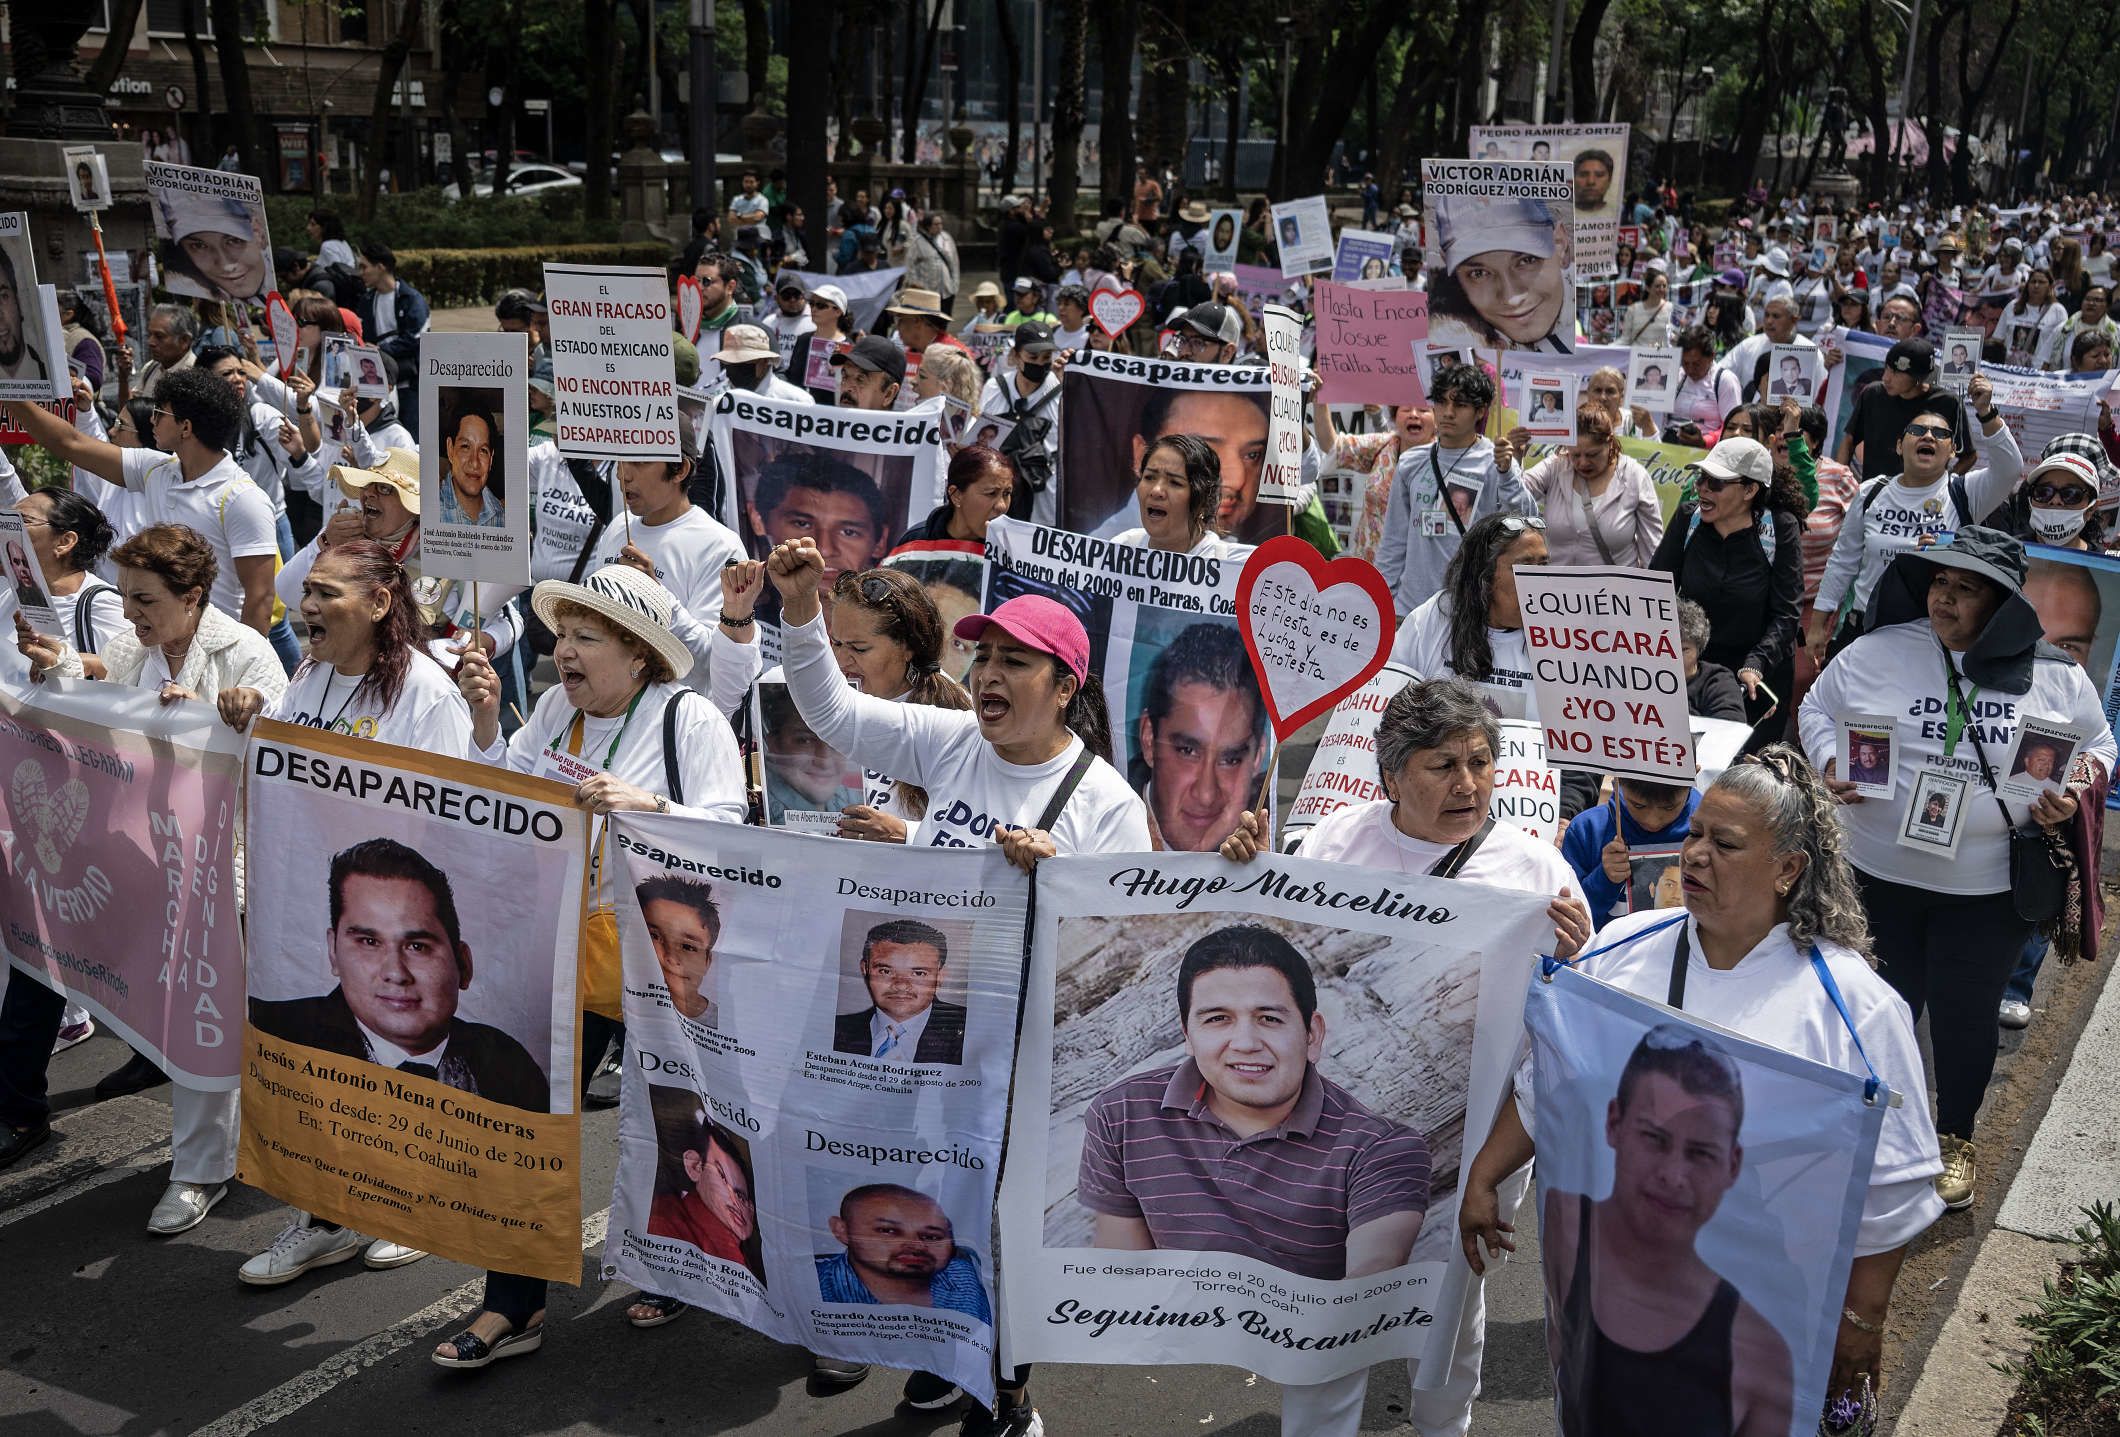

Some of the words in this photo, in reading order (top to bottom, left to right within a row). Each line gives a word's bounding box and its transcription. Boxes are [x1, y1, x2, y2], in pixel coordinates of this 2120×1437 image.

[1479, 128, 1520, 137] PEDRO
[1585, 126, 1624, 135] ORTIZ
[149, 166, 203, 182] VICTOR
[204, 172, 255, 192] ADRIÁN
[1429, 165, 1494, 181] VICTOR
[1499, 165, 1565, 183] ADRIÁN
[150, 176, 210, 195] RODRÍGUEZ
[212, 189, 260, 202] MORENO
[1427, 180, 1504, 197] RODRÍGUEZ
[1508, 184, 1570, 198] MORENO
[600, 285, 609, 295] EL
[551, 300, 592, 318] GRAN
[596, 302, 666, 320] FRACASO
[1321, 286, 1363, 319] Hasta
[1374, 299, 1427, 321] Encon
[600, 326, 616, 336] DEL
[1330, 318, 1389, 347] Josue
[555, 340, 597, 355] ESTADO
[601, 343, 669, 357] MEXICANO
[430, 359, 513, 381] Desaparecido
[606, 363, 615, 373] ES
[1376, 357, 1417, 375] Josue
[557, 377, 578, 392] NO
[582, 379, 672, 397] ENCONTRAR
[560, 402, 569, 415] A
[573, 402, 641, 419] NUESTROS
[645, 404, 651, 422] /
[656, 406, 674, 420] AS
[716, 391, 940, 445] Desaparecido
[561, 425, 676, 445] DESAPARECIDOS
[1264, 464, 1285, 485] NO
[435, 529, 456, 538] Antonio
[542, 527, 580, 543] FUUNDEC
[2043, 523, 2065, 533] HASTA
[541, 537, 577, 552] FUNDEM
[1031, 526, 1221, 587] DESAPARECIDOS
[984, 542, 998, 566] 24
[1016, 558, 1053, 582] enero
[1058, 568, 1079, 591] del
[1084, 573, 1123, 599] 2009
[1127, 585, 1145, 602] en
[1150, 585, 1203, 614] Parras,
[1210, 594, 1236, 616] Coa
[1260, 580, 1296, 606] Este
[1327, 606, 1347, 621] no
[1353, 614, 1368, 629] es
[1525, 588, 1631, 616] ¿QUIÉN
[1639, 596, 1673, 622] TE
[1252, 599, 1267, 616] de
[1320, 630, 1337, 644] es
[1343, 633, 1359, 651] de
[1258, 622, 1296, 651] Lucha
[1529, 626, 1678, 660] BUSCARÁ
[1262, 647, 1325, 680] Protesta
[1496, 677, 1507, 686] DEL
[1536, 659, 1679, 695] CUANDO
[1350, 717, 1360, 727] LA
[1562, 697, 1616, 722] ¿YO
[1624, 701, 1665, 729] YA
[1844, 721, 1893, 731] Desaparecido
[2025, 722, 2082, 742] Desaparecido
[550, 751, 563, 763] HIJO
[564, 758, 574, 768] FUE
[1336, 756, 1347, 765] ES
[1546, 728, 1593, 754] NO
[1602, 735, 1687, 767] ESTÉ?
[558, 764, 576, 778] DONDE
[1493, 769, 1557, 796] CARÁ
[255, 746, 563, 842] DESAPARECIDO
[1303, 772, 1313, 790] EL
[1316, 771, 1387, 801] CRIMEN
[41, 864, 115, 923] VERDAD
[150, 810, 186, 992] MARCHA
[836, 876, 996, 908] Desaparecido
[1108, 867, 1234, 909] Hugo
[1232, 869, 1459, 925] Marcelino
[193, 799, 227, 1049] DIGNIDAD
[706, 1029, 738, 1044] Herrera
[721, 1041, 731, 1051] de
[734, 1045, 756, 1057] 2009
[804, 1062, 856, 1077] Desaparecido
[857, 1071, 877, 1081] desde
[888, 1076, 898, 1084] 29
[901, 1077, 912, 1086] de
[914, 1079, 943, 1089] agosto
[945, 1079, 957, 1088] de
[959, 1079, 982, 1087] 2009
[806, 1050, 847, 1066] Esteban
[849, 1058, 879, 1072] Acosta
[882, 1064, 942, 1078] Rodríguez
[258, 1043, 295, 1071] Jesús
[300, 1059, 377, 1093] Antonio
[384, 1080, 434, 1110] Mena
[440, 1098, 535, 1141] Contreras
[803, 1071, 817, 1081] En:
[819, 1073, 846, 1085] Ramos
[846, 1079, 872, 1092] Arizpe,
[875, 1084, 913, 1095] Coahuila
[297, 1110, 323, 1132] En:
[329, 1120, 399, 1156] Torreón,
[405, 1143, 478, 1179] Coahuila
[330, 1098, 382, 1126] desde:
[388, 1114, 408, 1132] 29
[414, 1122, 433, 1139] de
[436, 1129, 480, 1157] Junio
[486, 1146, 507, 1163] de
[513, 1152, 563, 1172] 2010
[805, 1129, 984, 1170] Desaparecido
[271, 1140, 312, 1164] Esperes
[314, 1157, 336, 1174] Que
[338, 1168, 349, 1179] te
[352, 1171, 413, 1200] Olvidemos
[416, 1192, 424, 1204] y
[428, 1194, 446, 1208] No
[450, 1200, 497, 1222] Olvides
[500, 1217, 526, 1229] que
[530, 1222, 544, 1232] te
[347, 1185, 413, 1214] Esperamos
[623, 1228, 682, 1255] Gualberto
[667, 1266, 704, 1282] Arizpe,
[715, 1274, 726, 1284] 29
[728, 1277, 740, 1288] de
[1063, 1263, 1097, 1275] Fue
[1102, 1264, 1222, 1278] desaparecido
[1227, 1270, 1242, 1281] el
[1246, 1274, 1265, 1287] 20
[1269, 1280, 1287, 1297] de
[1290, 1289, 1326, 1306] julio
[1333, 1293, 1358, 1304] del
[1363, 1280, 1402, 1300] 2009
[1406, 1275, 1428, 1286] en
[1192, 1279, 1255, 1299] Torreón
[1260, 1292, 1305, 1316] Coah.
[811, 1308, 864, 1320] Gerardo
[867, 1312, 910, 1322] Acosta
[813, 1317, 877, 1329] Desaparecido
[878, 1322, 907, 1331] desde
[908, 1323, 917, 1331] el
[919, 1324, 931, 1332] 29
[933, 1327, 944, 1335] de
[1047, 1299, 1232, 1337] Seguimos
[1237, 1306, 1433, 1351] Buscandote
[833, 1328, 867, 1337] Ramos
[869, 1331, 902, 1341] Arizpe,
[905, 1332, 946, 1344] Coahuila
